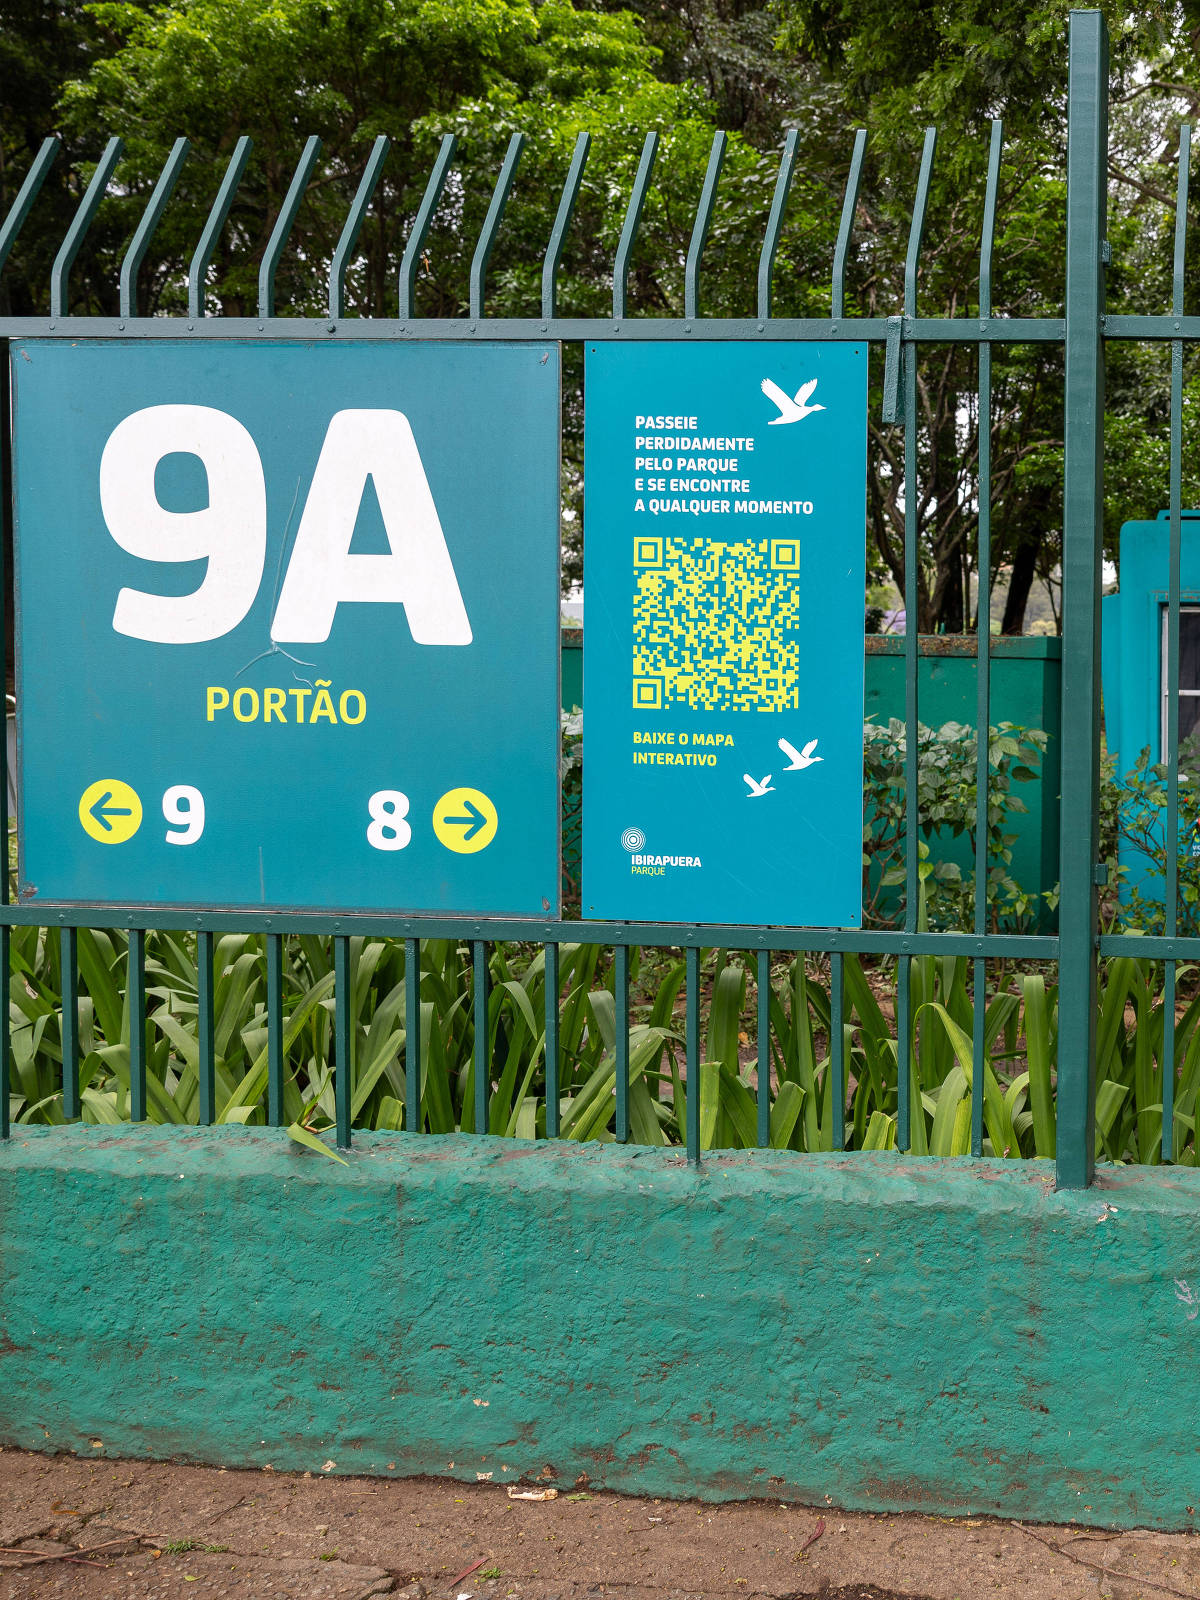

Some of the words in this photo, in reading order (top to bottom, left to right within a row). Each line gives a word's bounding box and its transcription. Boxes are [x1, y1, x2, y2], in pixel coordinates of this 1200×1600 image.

[635, 416, 698, 430] PASSEIE
[635, 437, 755, 451] PERDIDAMENTE
[635, 457, 673, 471] PELO
[677, 458, 738, 474] PARQUE
[635, 478, 644, 491] E
[647, 478, 666, 491] SE
[670, 479, 750, 492] ENCONTRE
[634, 499, 645, 512] A
[649, 499, 730, 516] QUALQUER
[734, 500, 814, 514] MOMENTO
[99, 404, 473, 646] 9A
[207, 679, 367, 725] PORTÃO
[633, 732, 675, 745] BAIXE
[678, 733, 689, 745] O
[692, 733, 735, 746] MAPA
[633, 752, 717, 767] INTERATIVO
[162, 784, 205, 846] 9
[366, 790, 412, 851] 8
[631, 855, 702, 867] IBIRAPUERA
[631, 866, 665, 876] PARQUE
